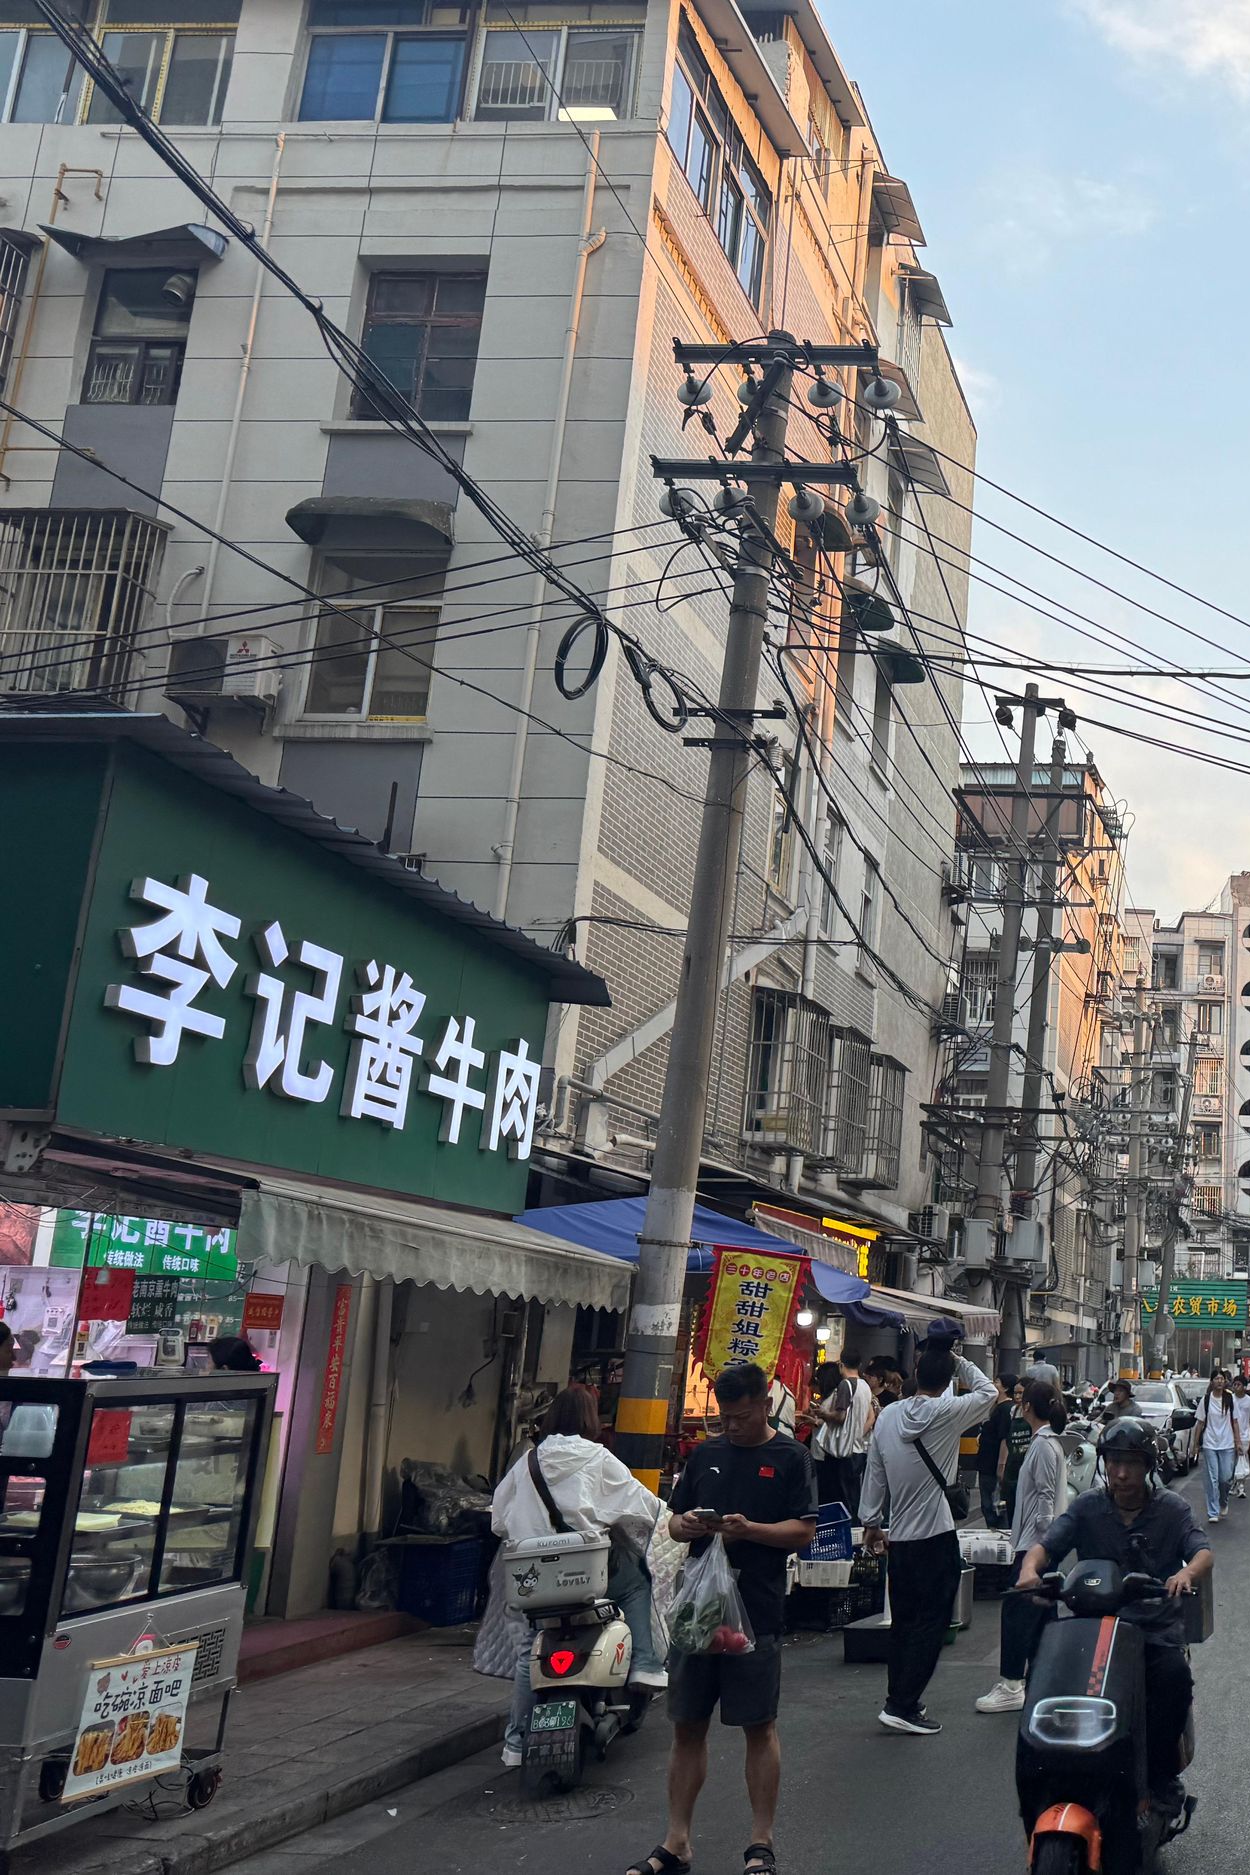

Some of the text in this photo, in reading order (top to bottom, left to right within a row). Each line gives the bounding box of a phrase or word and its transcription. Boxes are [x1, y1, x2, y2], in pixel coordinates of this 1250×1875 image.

[104, 873, 541, 1160] 李记酱牛肉
[104, 1250, 200, 1272] 传统做法 传统口味
[726, 1264, 791, 1283] 三十年老店
[556, 1576, 591, 1588] LOVELY
[141, 1655, 182, 1679] 爱上凉皮
[94, 1679, 182, 1720] 吃碗凉面吧
